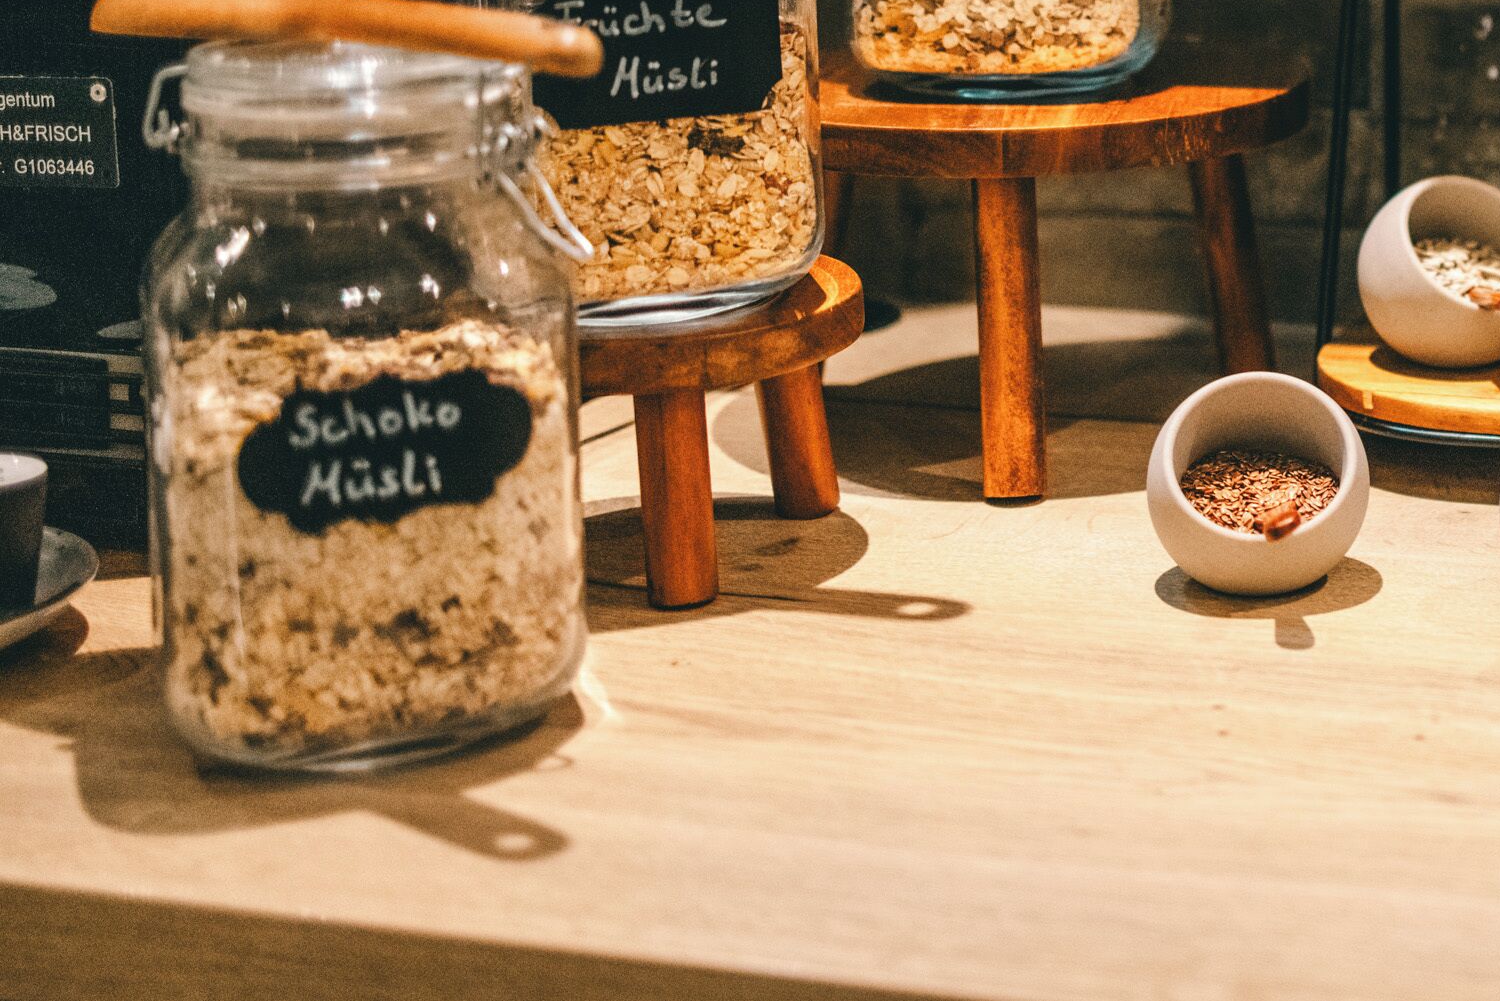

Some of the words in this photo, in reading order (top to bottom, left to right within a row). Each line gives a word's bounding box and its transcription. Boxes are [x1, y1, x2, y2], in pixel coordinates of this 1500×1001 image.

[610, 55, 718, 99] Müsli
[14, 158, 96, 175] G1063446
[288, 391, 462, 449] Schoko
[300, 449, 443, 507] Müsli
